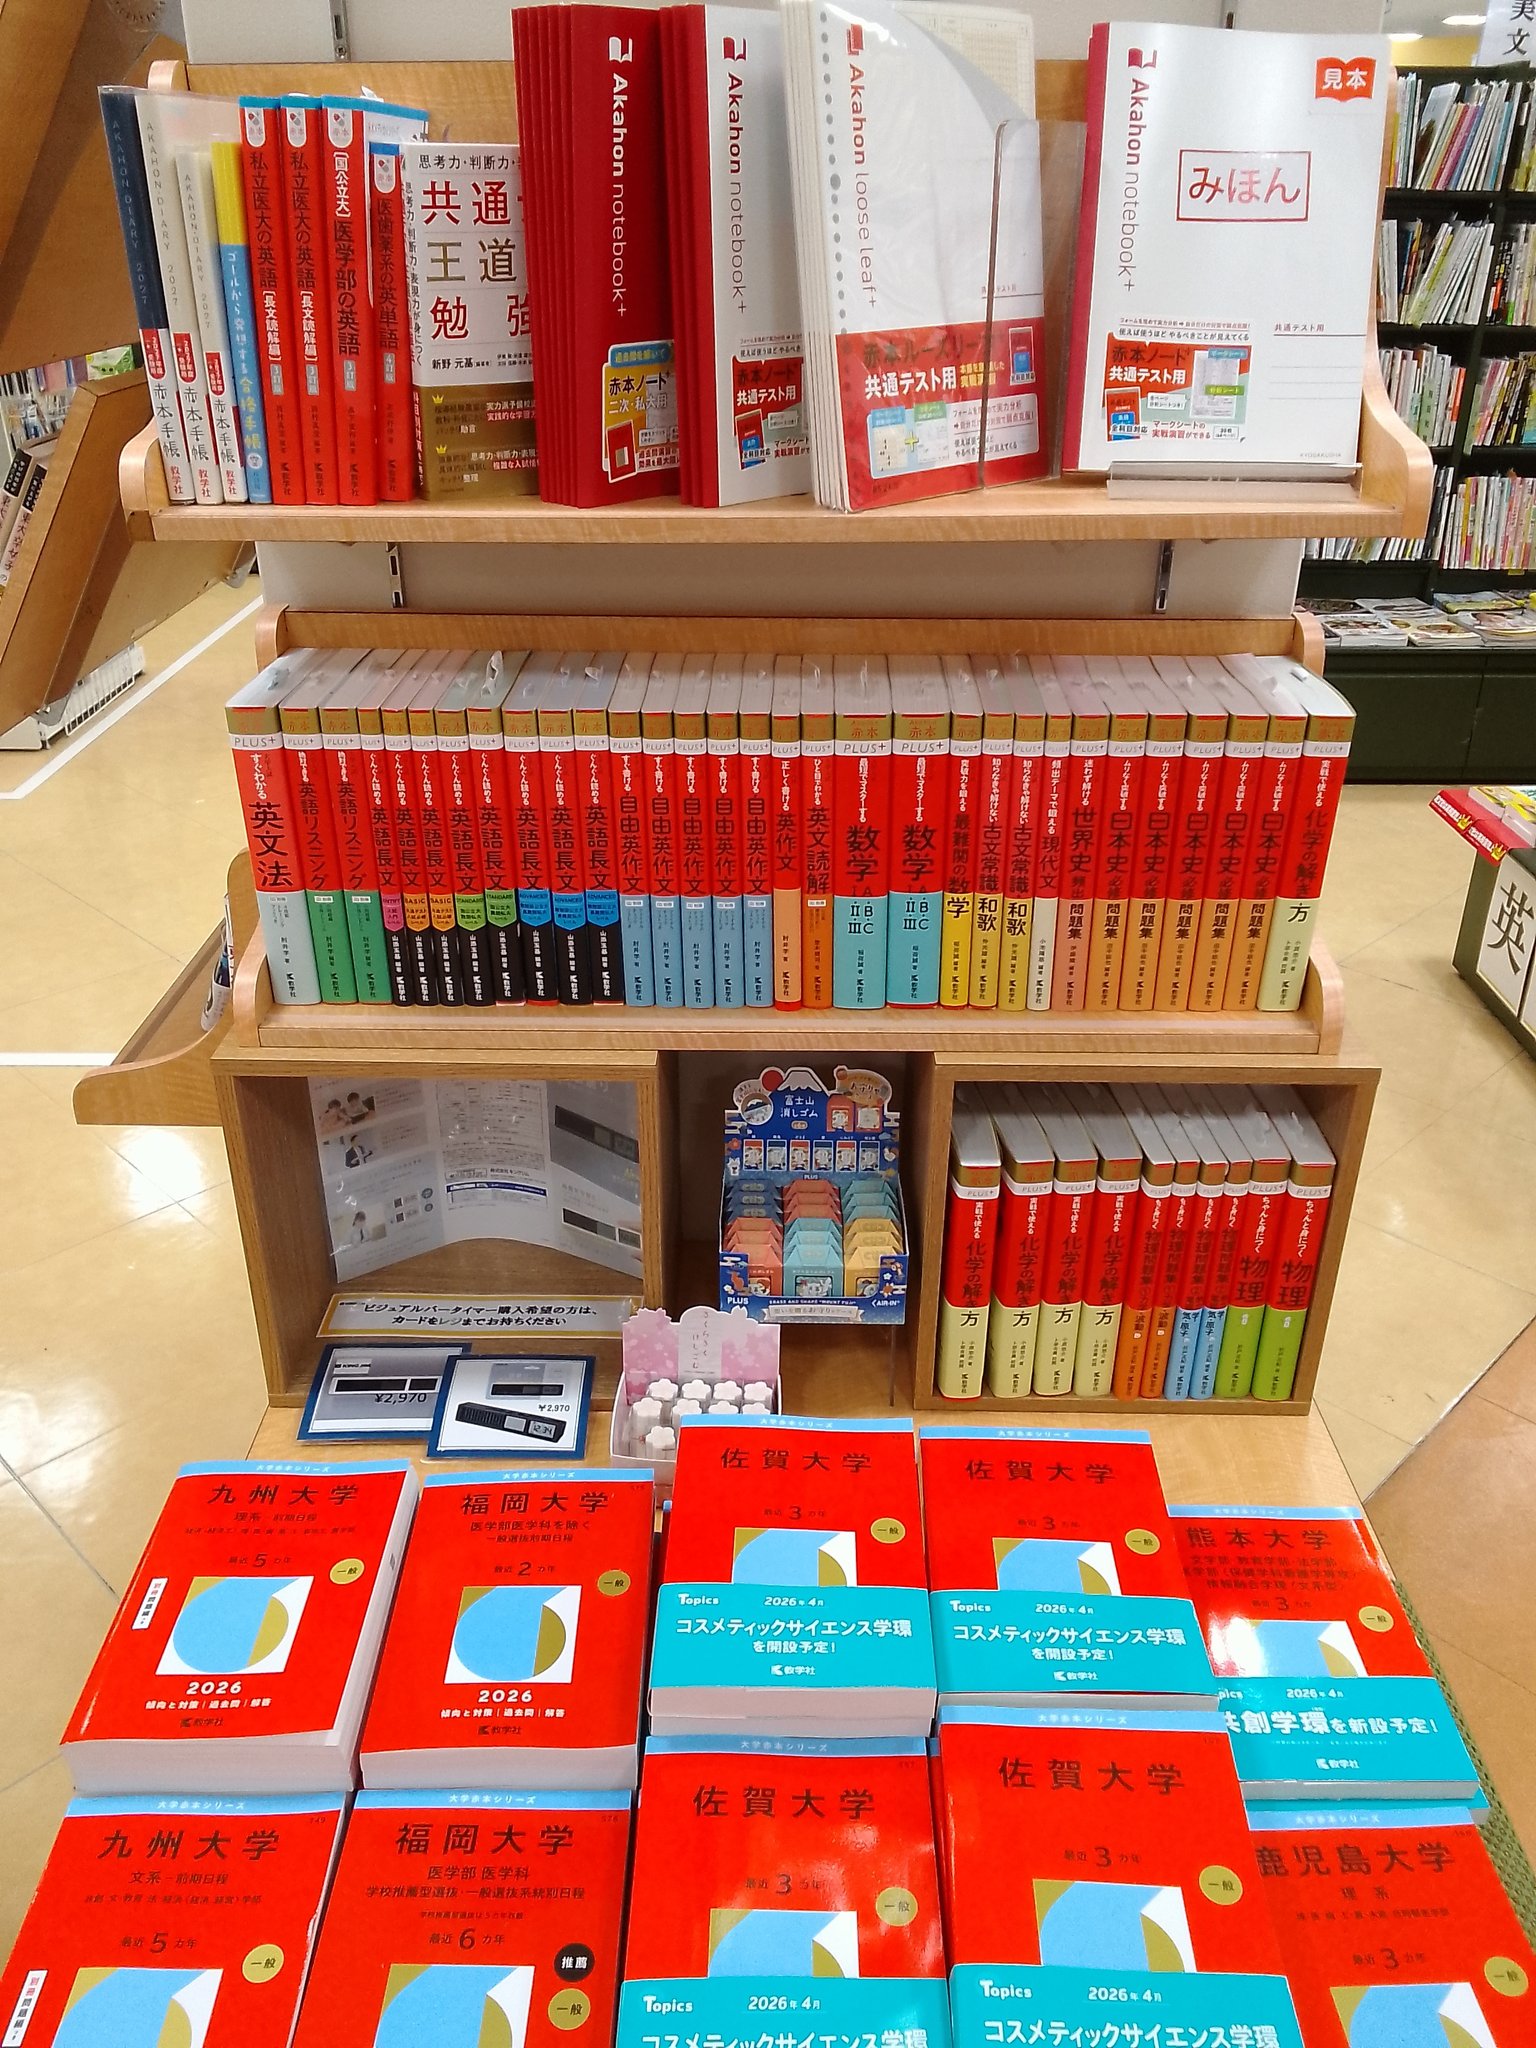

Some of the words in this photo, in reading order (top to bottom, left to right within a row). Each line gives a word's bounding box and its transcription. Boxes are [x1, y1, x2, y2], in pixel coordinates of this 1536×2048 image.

[1322, 67, 1367, 90] 見本
[612, 73, 628, 178] Akahon
[727, 72, 743, 174] Akahon
[849, 64, 867, 165] Akahon
[1127, 78, 1149, 166] Akahon
[422, 181, 528, 225] 共通
[1189, 167, 1301, 205] みほん
[250, 152, 278, 288] 私立医大の英語
[289, 152, 316, 288] 私立医大の英語
[855, 171, 871, 240] loose
[610, 182, 627, 317] notebook+
[730, 182, 747, 314] notebook+
[1118, 171, 1140, 292] notebook+
[427, 237, 516, 283] 王道
[858, 246, 877, 308] leaf+
[167, 265, 178, 305] 2027
[334, 220, 360, 356] 医学部の英語
[1275, 323, 1324, 332] 共通テスト用
[432, 357, 452, 369] 新野
[1109, 366, 1186, 384] 共通テスト用
[737, 385, 796, 406] 共通テスト用
[865, 366, 957, 399] 共通テスト用
[154, 383, 180, 458] 赤本手帳
[609, 394, 667, 414] 二次・私大用
[184, 386, 209, 460] 赤本手帳
[214, 399, 235, 463] 赤本手帳
[171, 466, 183, 494] 教学社
[199, 469, 210, 497] 教学社
[226, 470, 237, 494] 教学社
[250, 753, 267, 800] すぐわかる
[249, 802, 293, 887] 英文法
[299, 783, 327, 890] 英語リスニング
[338, 783, 363, 890] 英語リスニング
[371, 808, 396, 887] 英語長文
[395, 808, 420, 887] 英語長文
[422, 808, 447, 887] 英語長文
[449, 807, 476, 892] 英語長文
[479, 806, 509, 891] 英語長文
[516, 806, 545, 891] 英語長文
[550, 806, 577, 892] 英語長文
[585, 805, 617, 891] 英語長文
[620, 796, 643, 891] 自由英作文
[651, 797, 675, 893] 自由英作文
[683, 797, 706, 894] 自由英作文
[715, 798, 739, 893] 自由英作文
[746, 798, 769, 894] 自由英作文
[775, 813, 797, 871] 英作文
[806, 806, 831, 895] 英文読解
[846, 825, 880, 882] 数学
[902, 824, 937, 881] 数学
[1039, 836, 1060, 890] 現代文
[1487, 882, 1535, 975] 英
[784, 1095, 814, 1106] 富士山
[1236, 1255, 1269, 1302] 物理
[1279, 1259, 1312, 1307] 物理
[727, 1297, 749, 1305] PLUS
[374, 1393, 427, 1404] ¥2,970
[538, 1404, 570, 1413] ¥2,970
[720, 1448, 872, 1473] 佐賀大学
[966, 1460, 1116, 1484] 佐賀大学
[206, 1484, 359, 1506] 九州大学
[460, 1492, 609, 1516] 福岡大学
[470, 1520, 591, 1532] 医学部医学科を除く
[876, 1527, 899, 1536] 一般
[1185, 1527, 1332, 1549] 熊本大学
[336, 1565, 359, 1576] 一般
[603, 1579, 625, 1588] 一般
[678, 1593, 719, 1606] Topics
[949, 1600, 991, 1613] Topics
[675, 1618, 913, 1637] コスメティックサイエンス学環
[952, 1625, 1187, 1646] コスメティックサイエンス学環
[753, 1641, 836, 1654] を開設予定!
[1032, 1648, 1115, 1661] を開設予定!
[185, 1681, 243, 1695] 2026
[478, 1690, 533, 1704] 2026
[998, 1757, 1186, 1795] 佐賀大学
[693, 1785, 875, 1820] 佐賀大学
[96, 1830, 280, 1860] 九州大学
[395, 1823, 575, 1856] 福岡大学
[129, 1871, 161, 1884] 文系
[427, 1866, 476, 1880] 医学部
[481, 1866, 530, 1880] 医学科
[1255, 1843, 1455, 1877] 鹿児島大学
[1207, 1880, 1234, 1893] 一般
[883, 1901, 910, 1913] 一般
[250, 1958, 277, 1969] 一般
[561, 1956, 588, 1970] 推薦
[642, 1995, 693, 2015] Topics
[978, 1979, 1033, 2000] Topics
[556, 2003, 583, 2016] 一般
[983, 2020, 1280, 2048] コスメティックサイエンス学環
